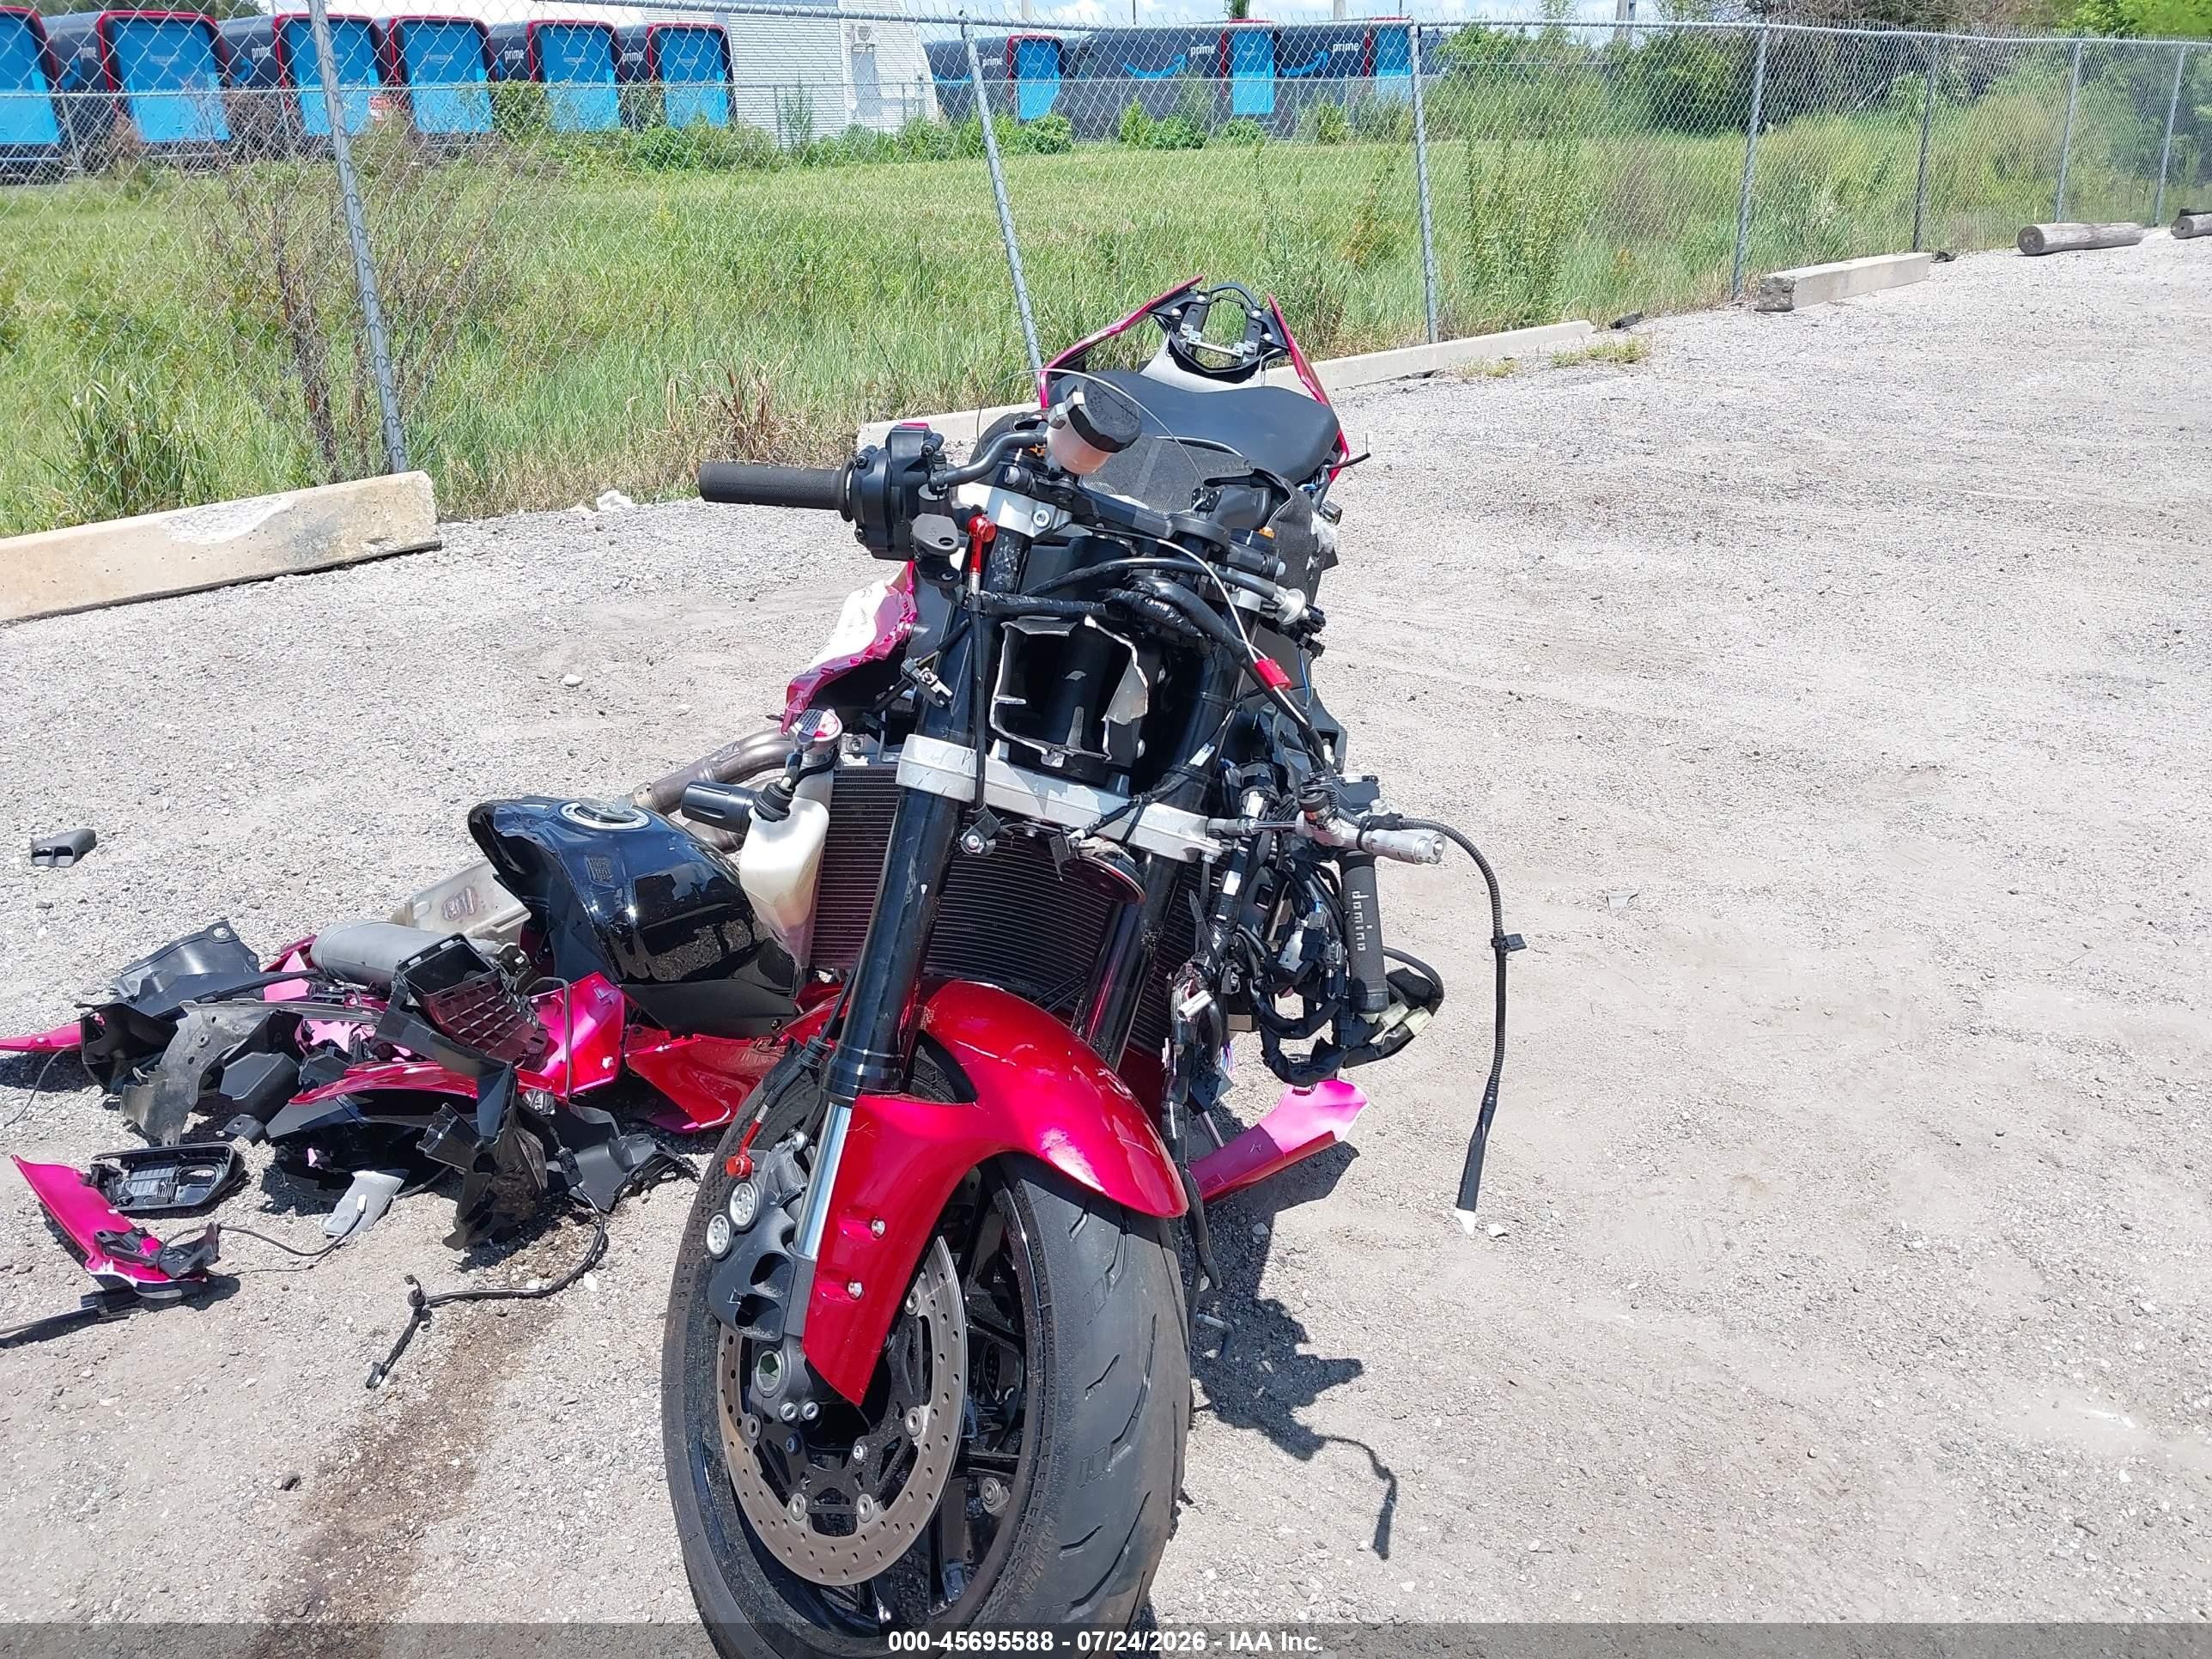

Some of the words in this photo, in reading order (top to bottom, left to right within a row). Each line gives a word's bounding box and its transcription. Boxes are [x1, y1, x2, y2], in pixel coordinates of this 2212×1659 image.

[1190, 43, 1217, 58] prime
[1333, 40, 1360, 52] prime
[504, 46, 524, 64] prime
[622, 49, 643, 65] prime
[982, 55, 1003, 67] prime
[1352, 890, 1373, 951] domino
